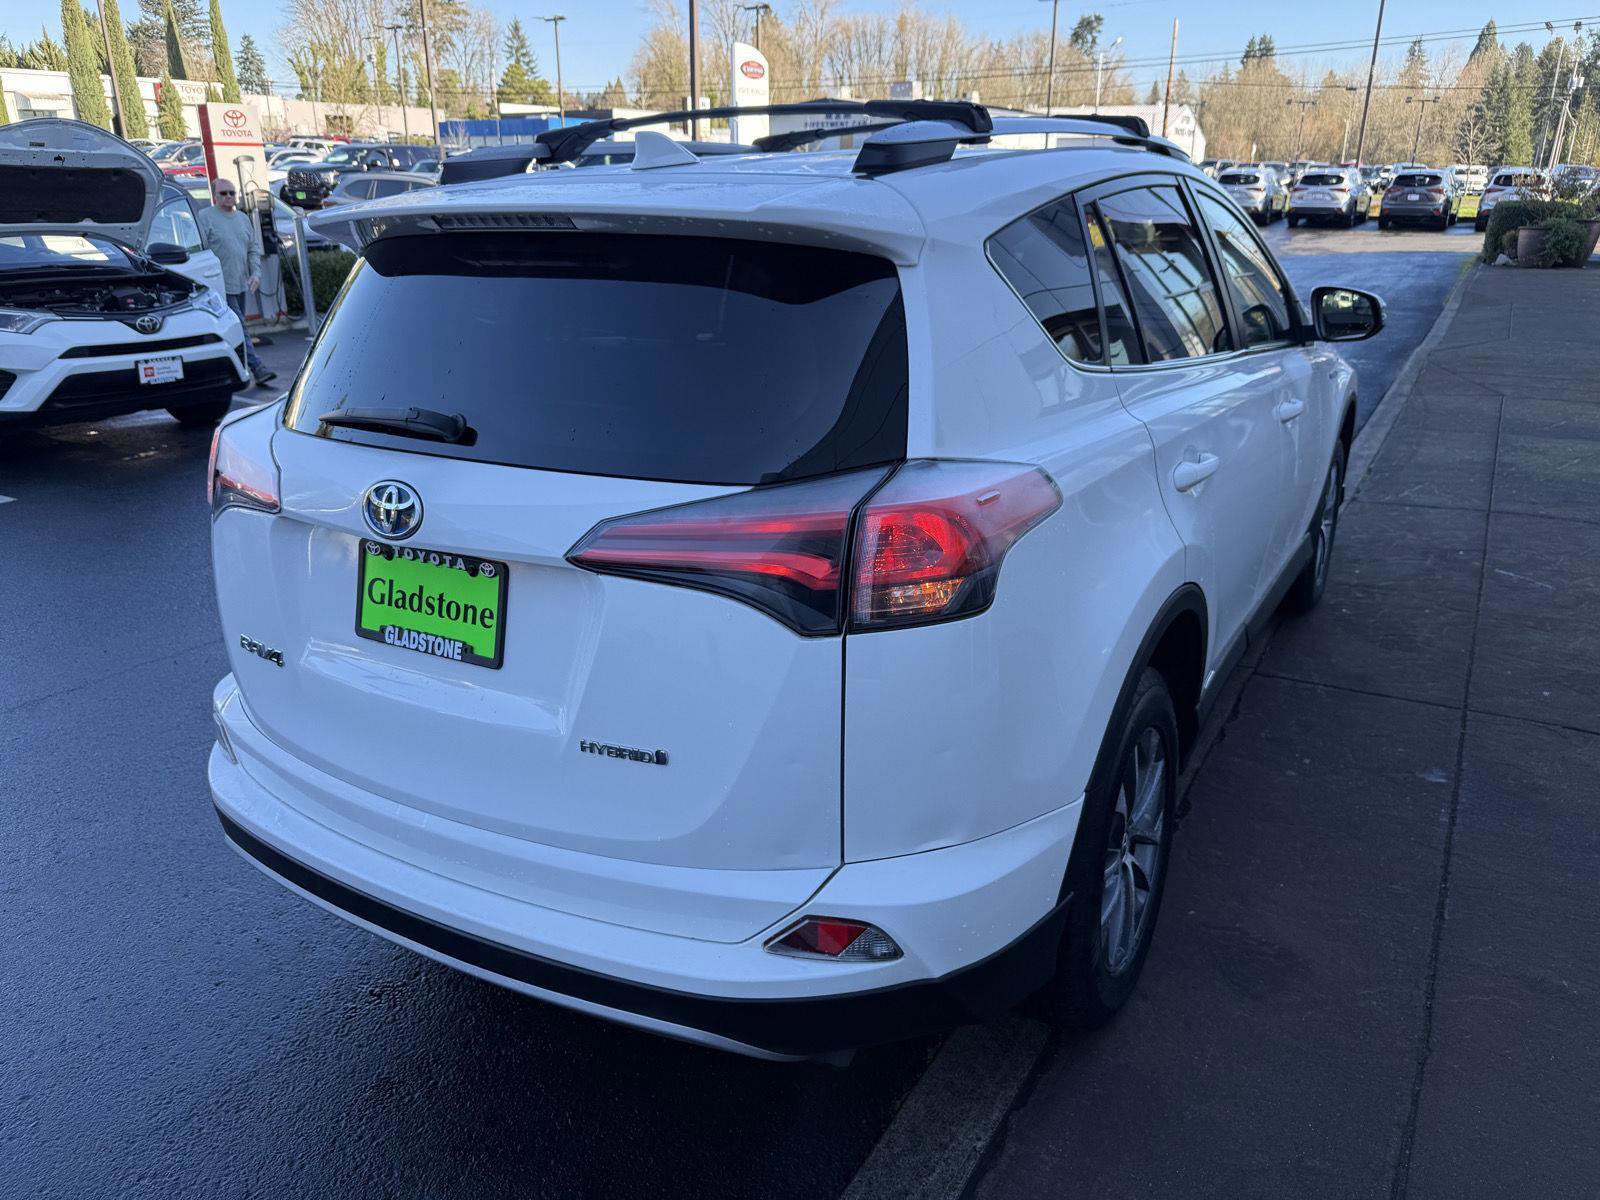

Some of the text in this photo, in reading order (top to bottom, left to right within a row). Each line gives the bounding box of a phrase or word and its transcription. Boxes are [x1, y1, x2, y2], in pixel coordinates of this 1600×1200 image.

[221, 129, 253, 137] TOYOTA
[392, 546, 466, 571] TOYOTA
[367, 577, 495, 629] Gladstone
[384, 625, 463, 661] GLADSTONE
[580, 739, 655, 764] HYBRID
